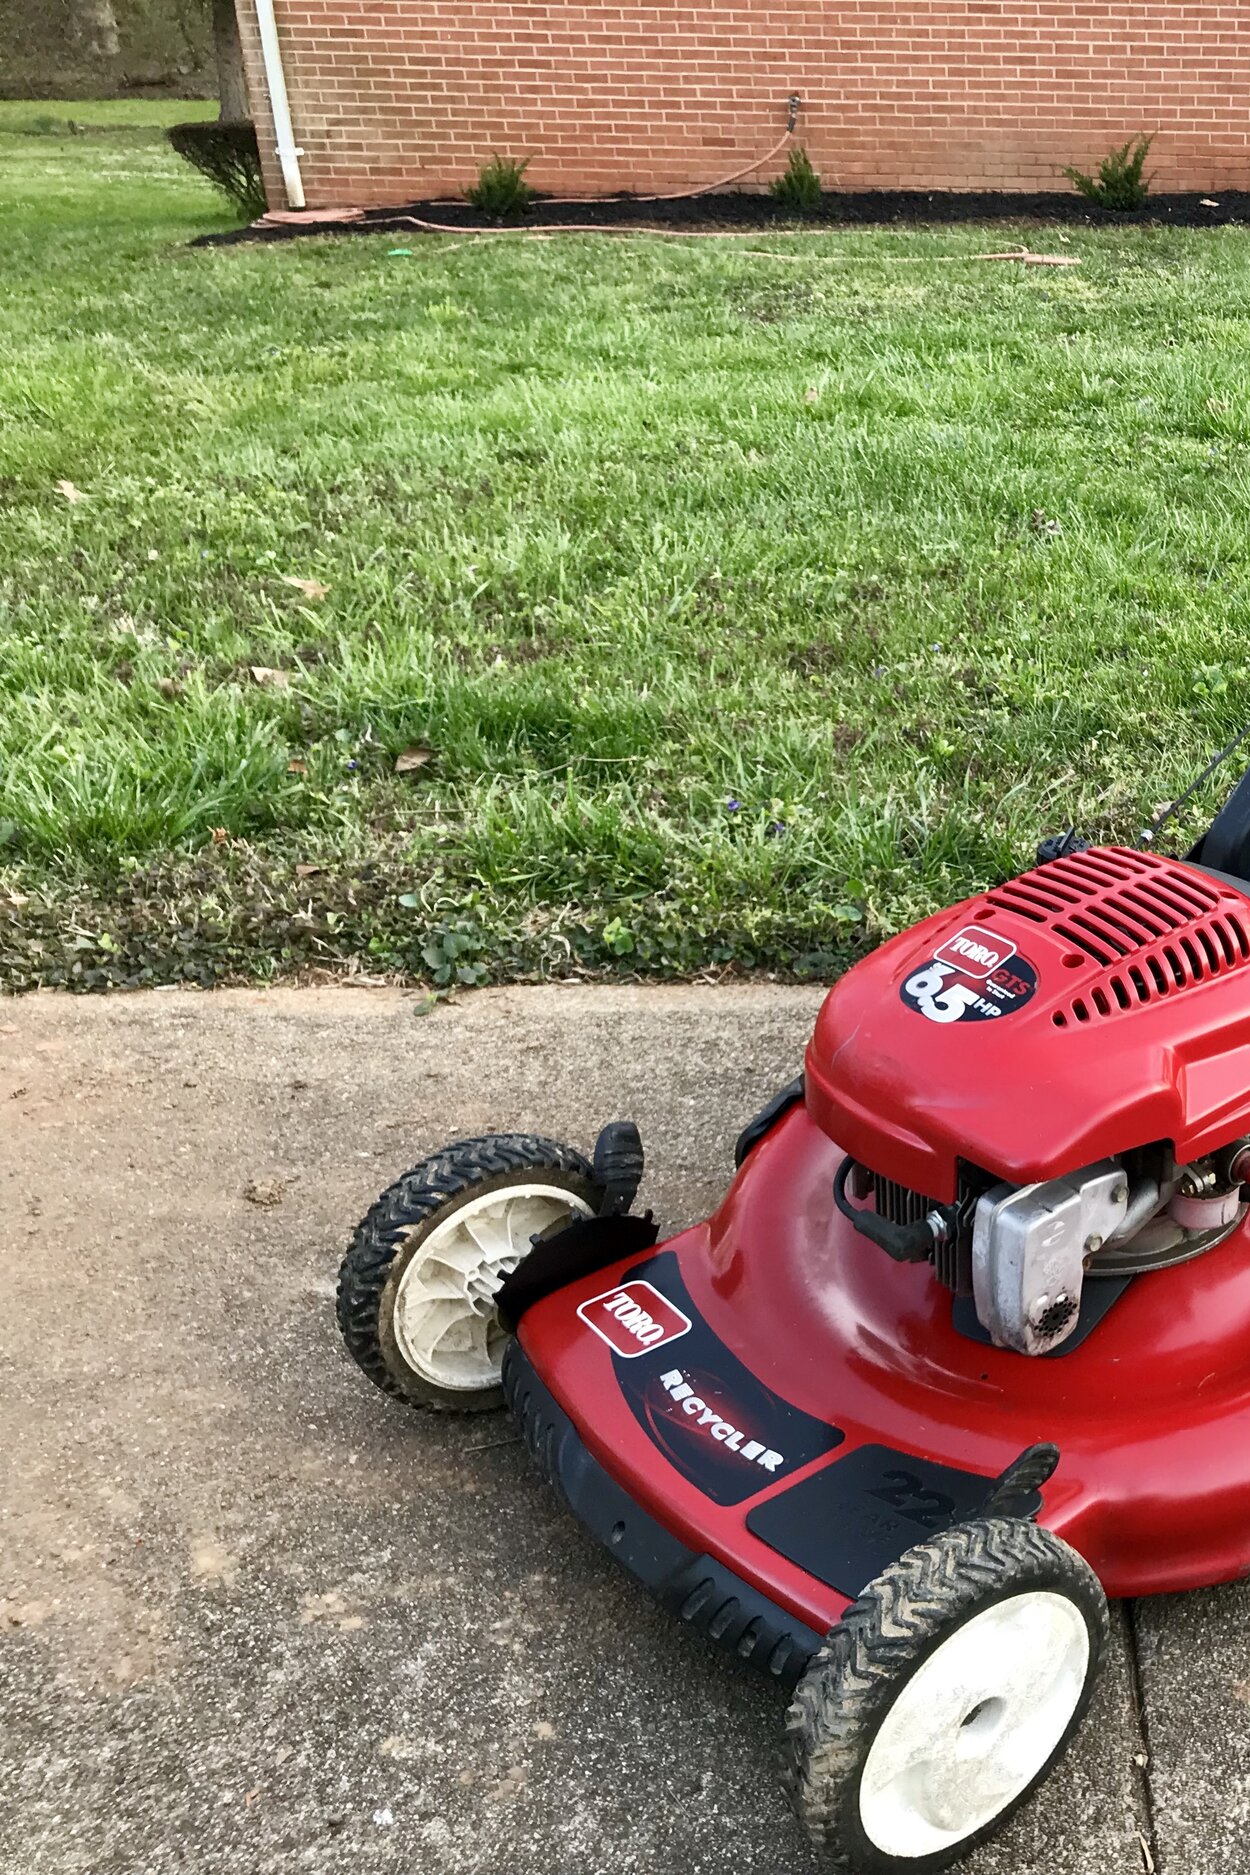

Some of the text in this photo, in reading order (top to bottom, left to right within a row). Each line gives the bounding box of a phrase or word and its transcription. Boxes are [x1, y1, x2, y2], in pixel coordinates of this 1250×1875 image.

[949, 937, 999, 968] TORO
[992, 968, 1031, 995] GTS
[973, 998, 1002, 1016] HP
[603, 1292, 664, 1346] TORO
[660, 1369, 784, 1472] RECYCLER
